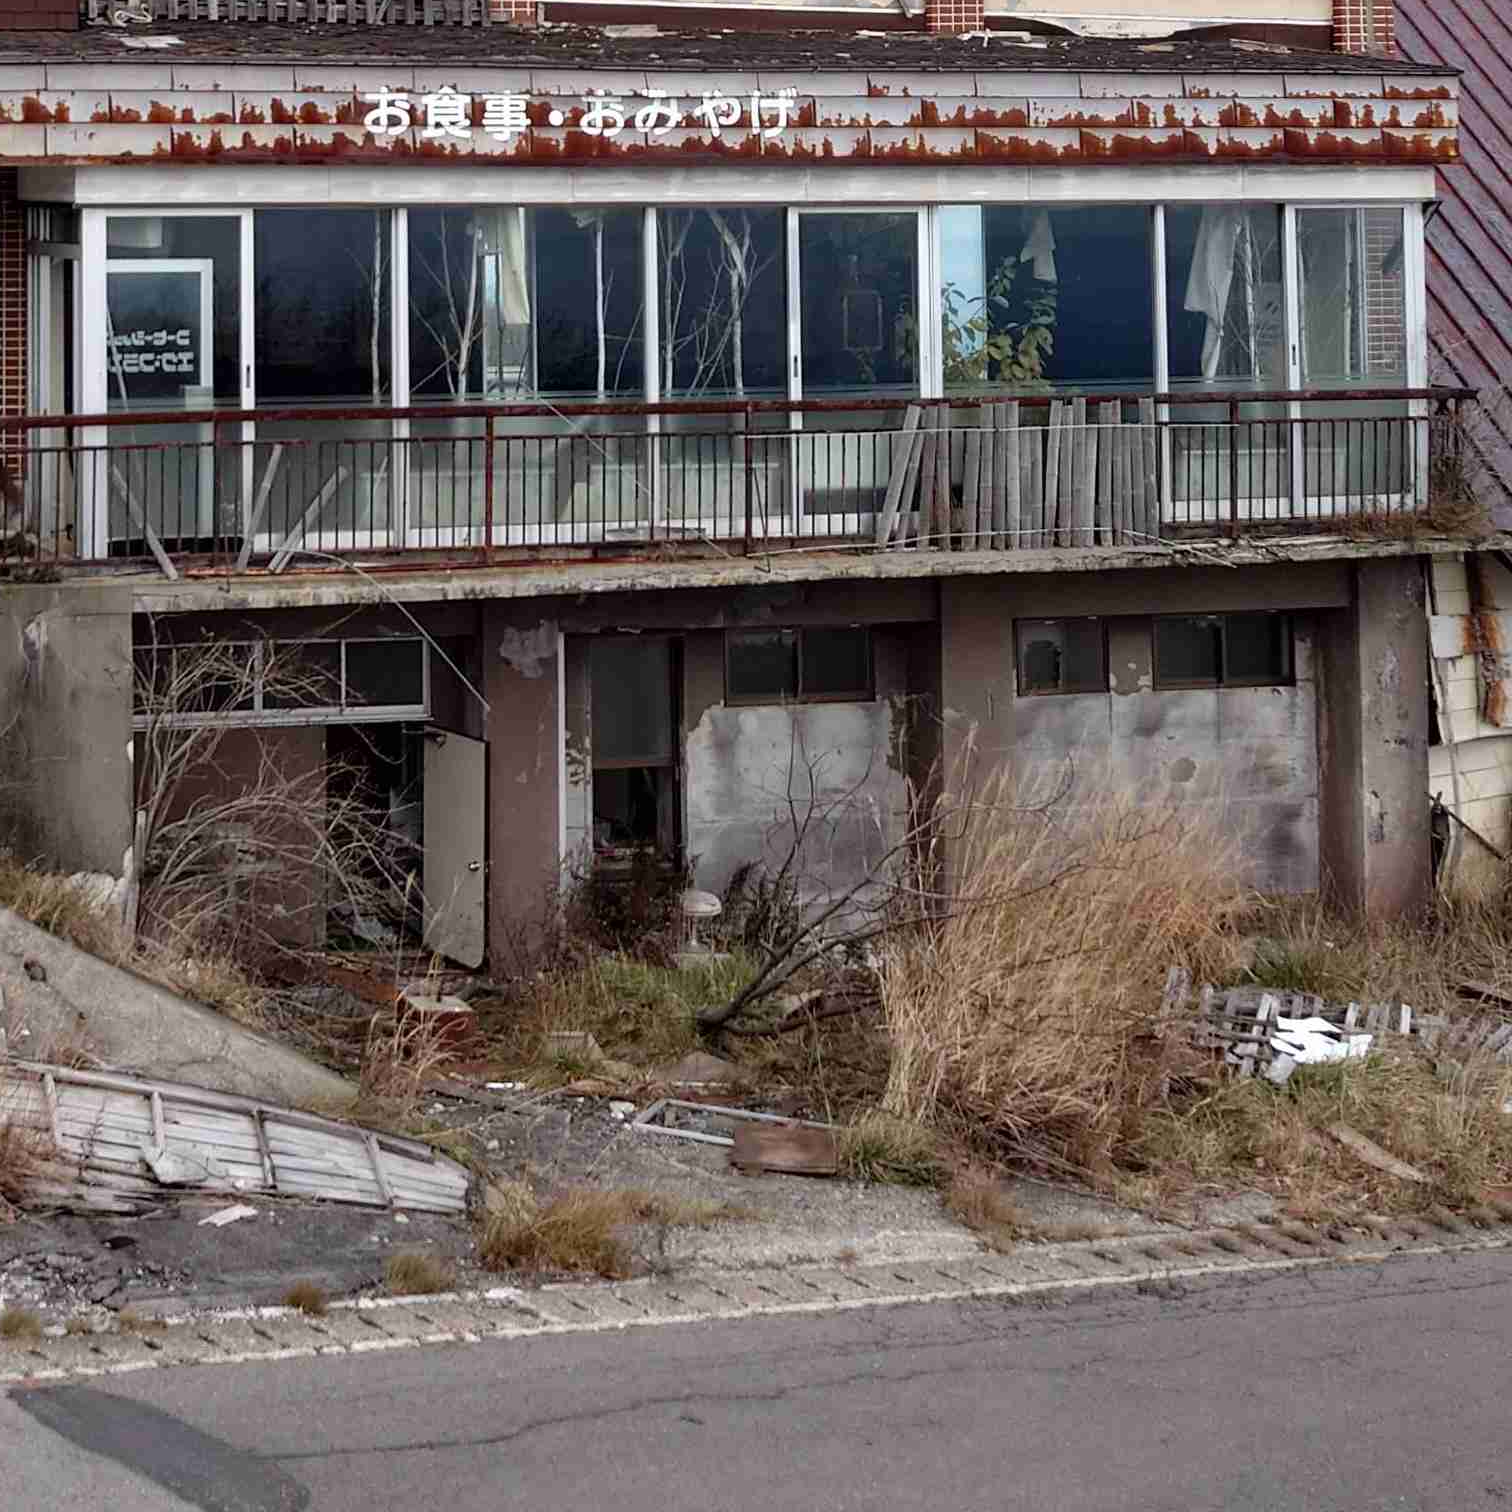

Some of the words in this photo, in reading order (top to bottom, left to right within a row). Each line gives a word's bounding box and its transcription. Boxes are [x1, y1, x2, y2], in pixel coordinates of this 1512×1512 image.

[364, 86, 799, 141] お食事・おみやげ
